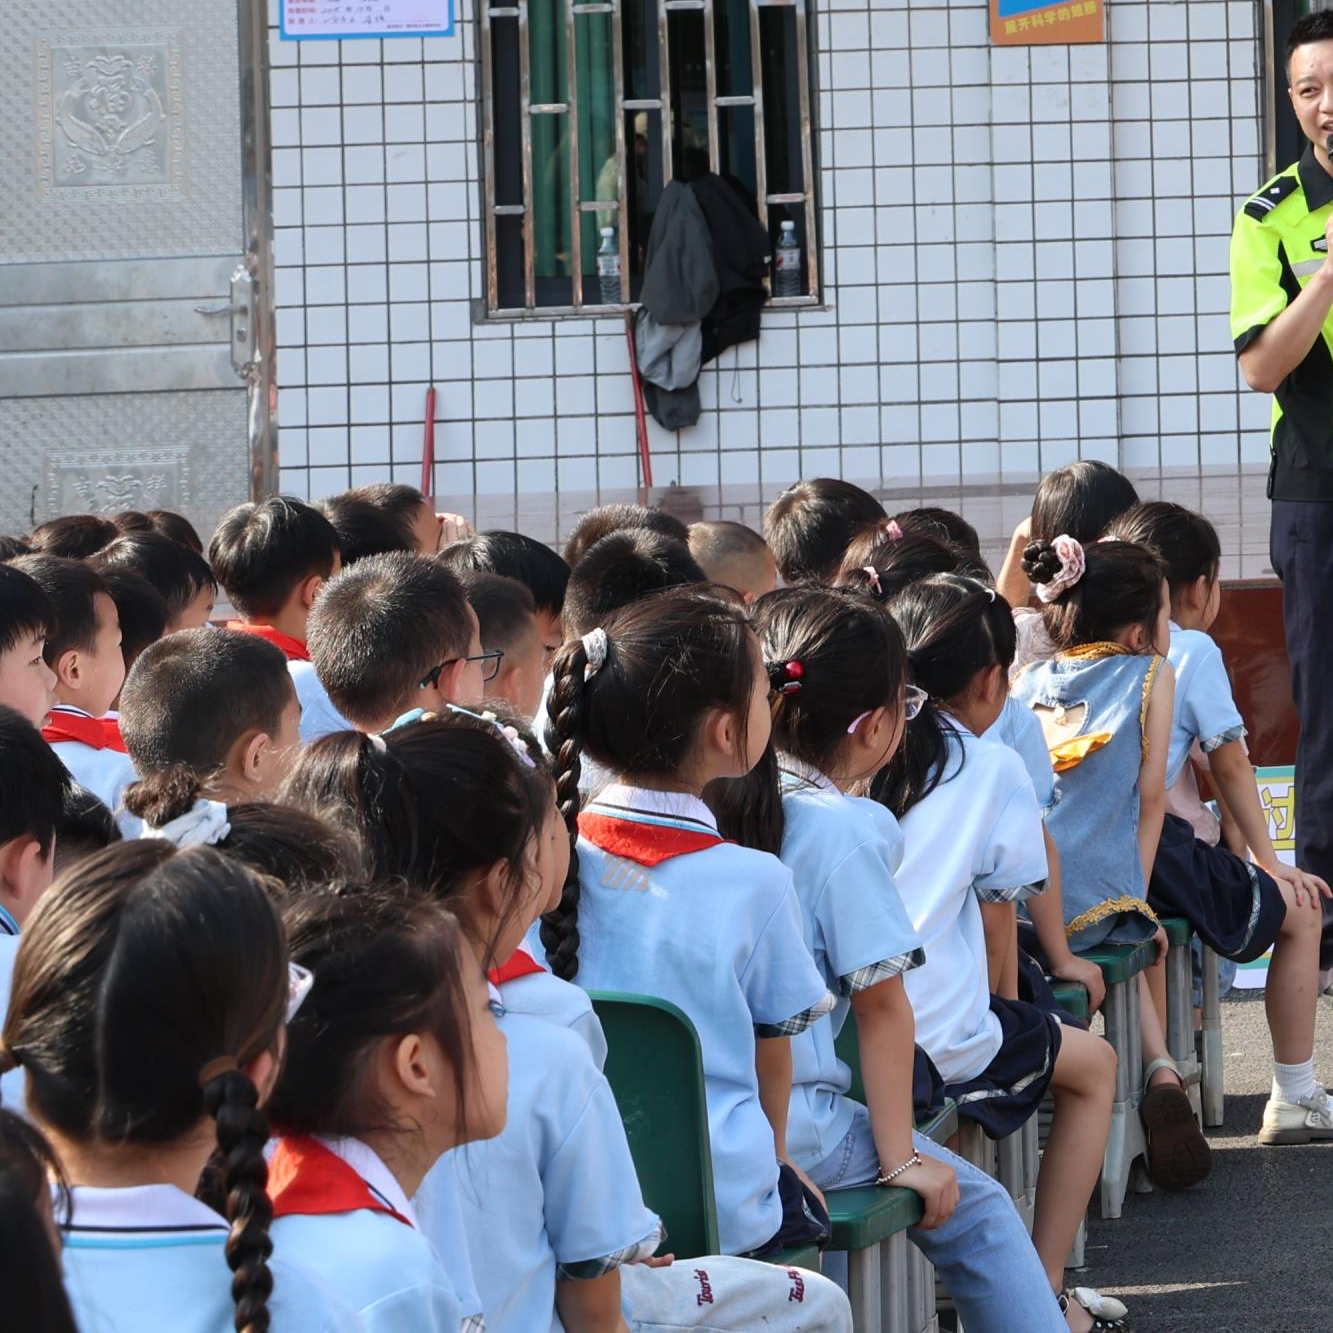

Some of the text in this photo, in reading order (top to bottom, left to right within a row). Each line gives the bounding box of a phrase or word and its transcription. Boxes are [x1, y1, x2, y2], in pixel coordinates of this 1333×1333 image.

[1003, 0, 1098, 35] 展开科学的翅膀
